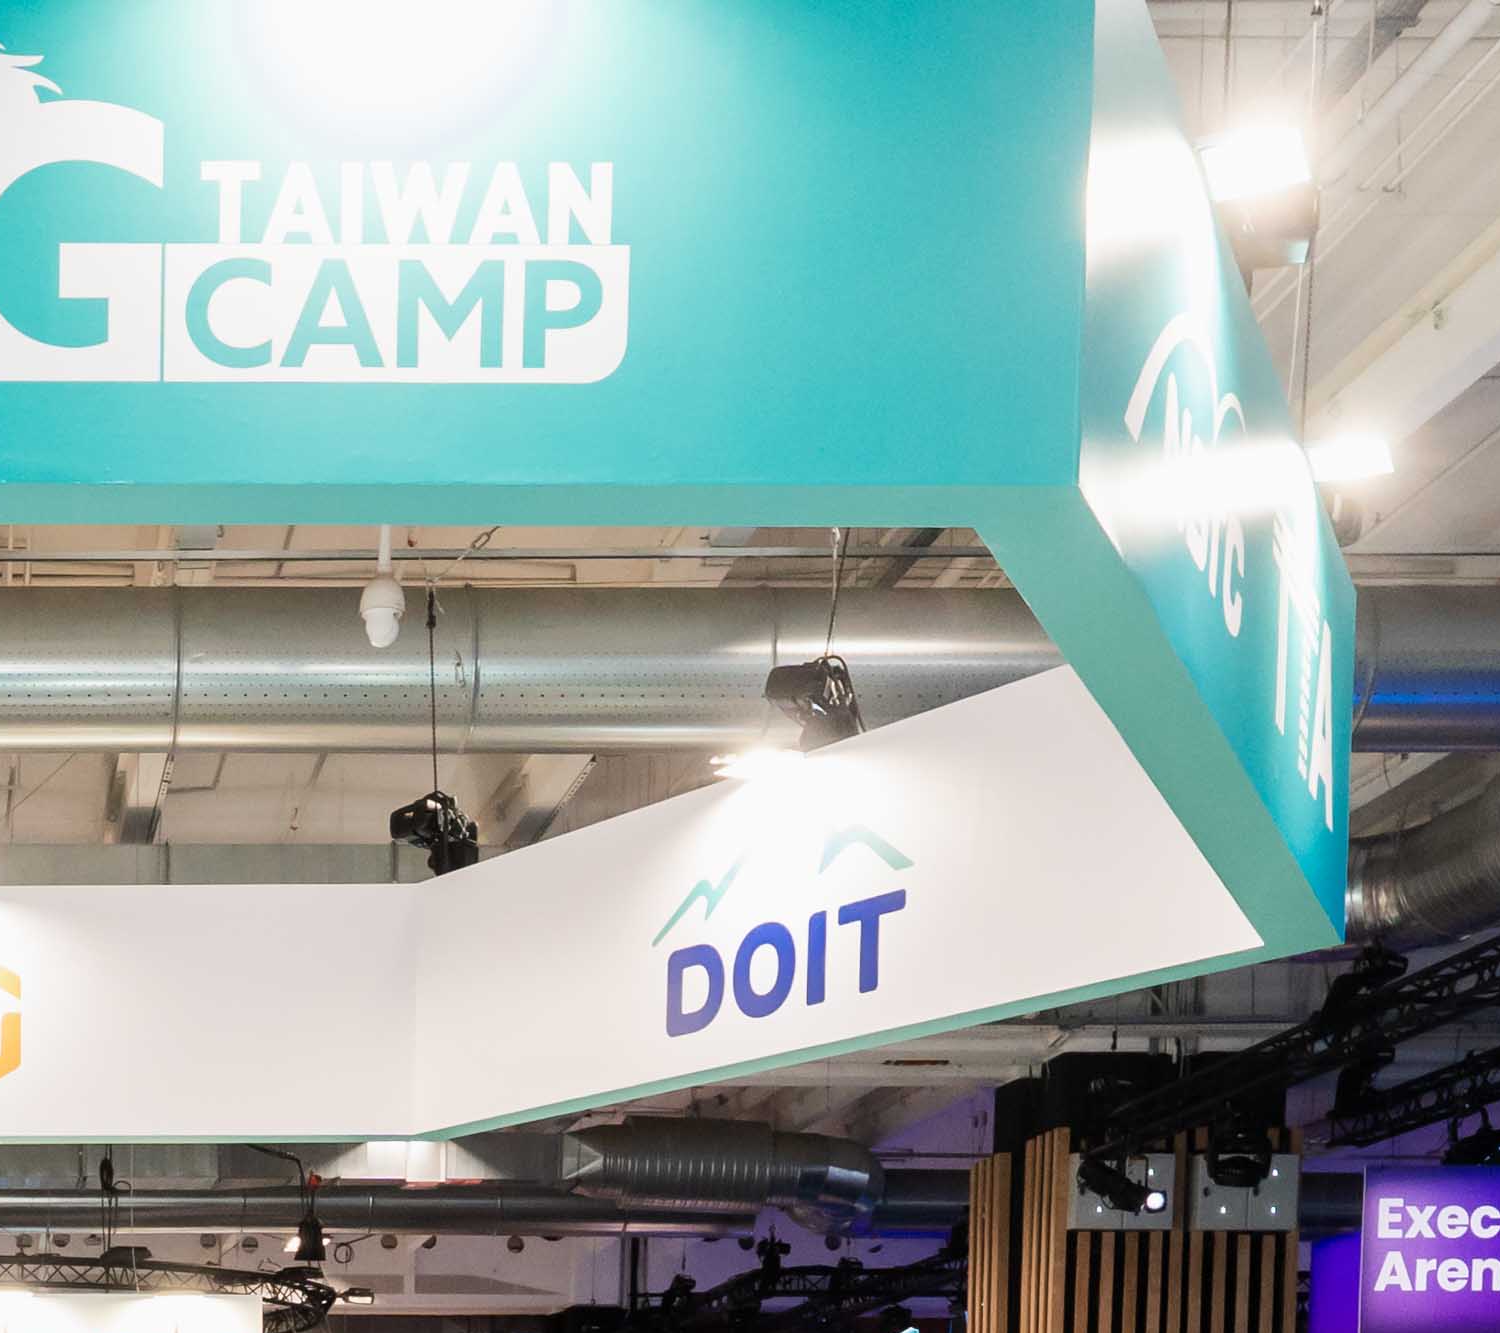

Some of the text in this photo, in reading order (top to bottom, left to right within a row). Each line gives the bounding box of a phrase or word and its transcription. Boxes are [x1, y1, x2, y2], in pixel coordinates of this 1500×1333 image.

[197, 162, 615, 246] TAIWAN
[183, 258, 613, 371] CAMP
[662, 895, 903, 1033] DOIT
[1377, 1197, 1500, 1240] Exec
